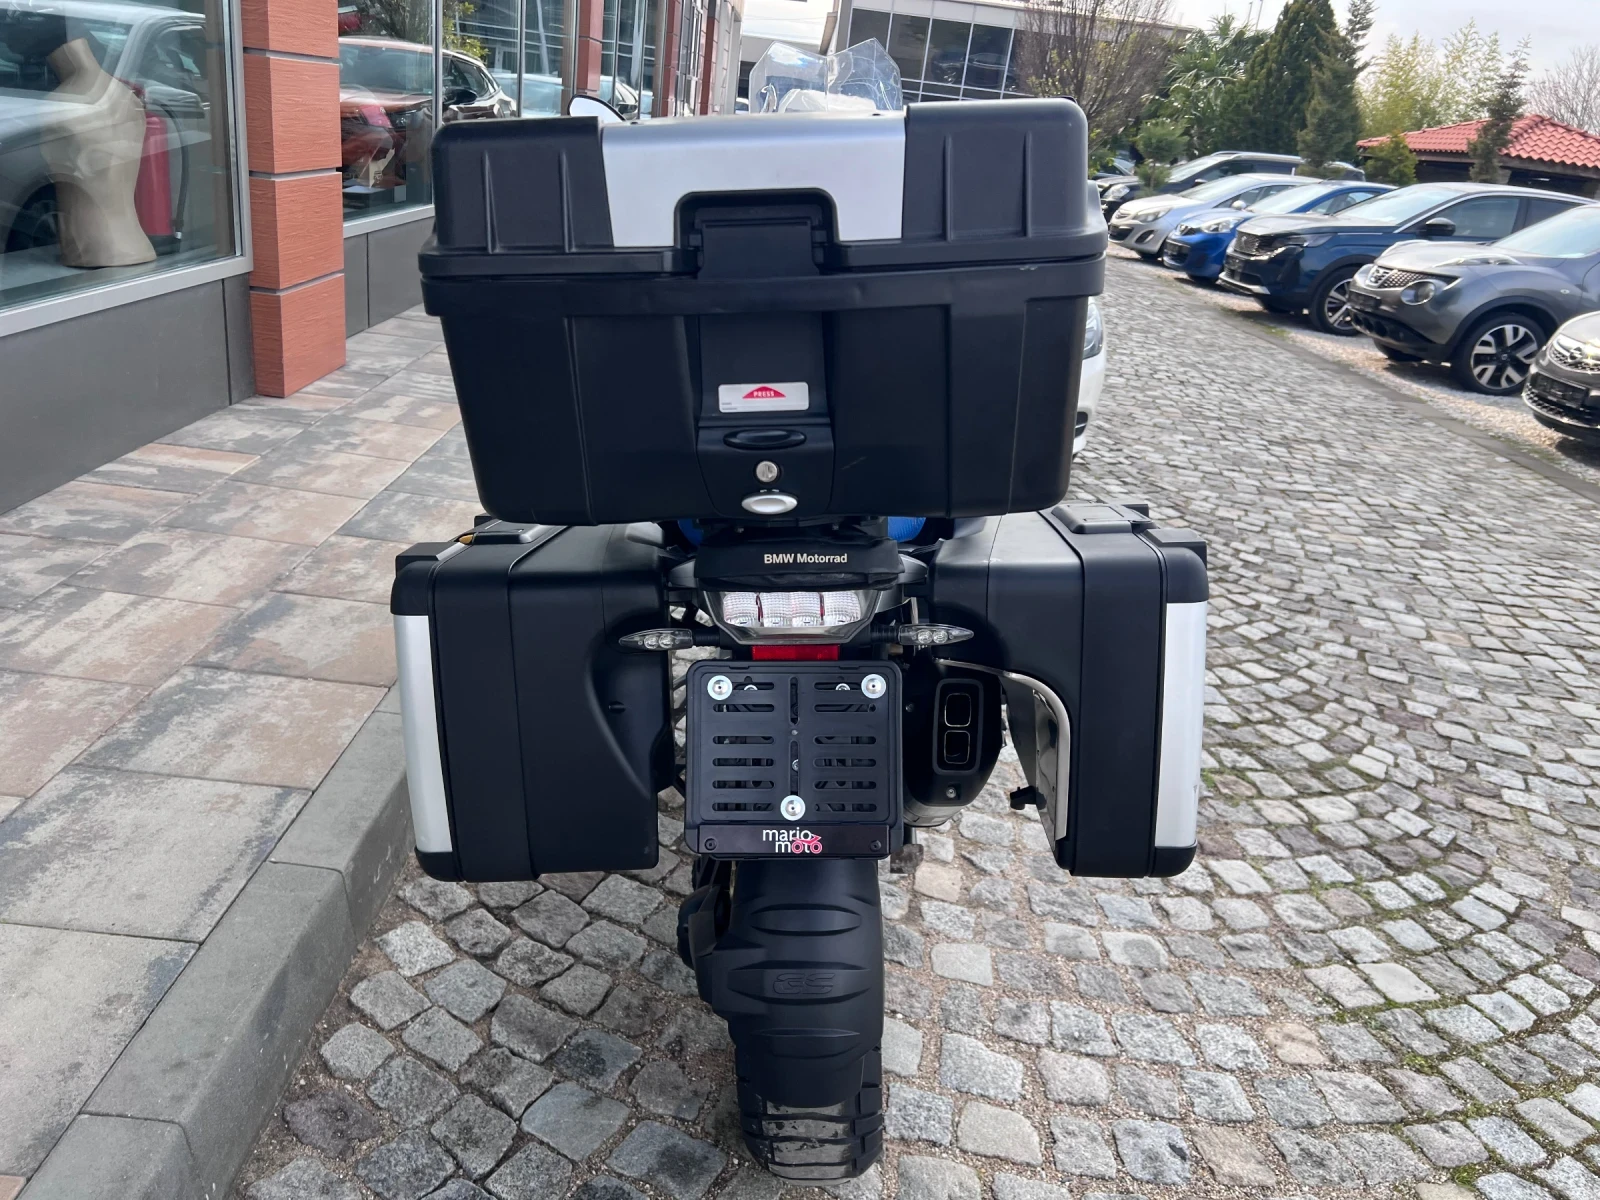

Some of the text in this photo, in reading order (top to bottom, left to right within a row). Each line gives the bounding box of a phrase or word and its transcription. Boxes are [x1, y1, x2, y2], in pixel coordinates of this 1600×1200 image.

[764, 553, 848, 564] BMW Motorrad
[762, 827, 812, 841] mario
[775, 840, 823, 854] moto
[772, 973, 836, 994] GS
